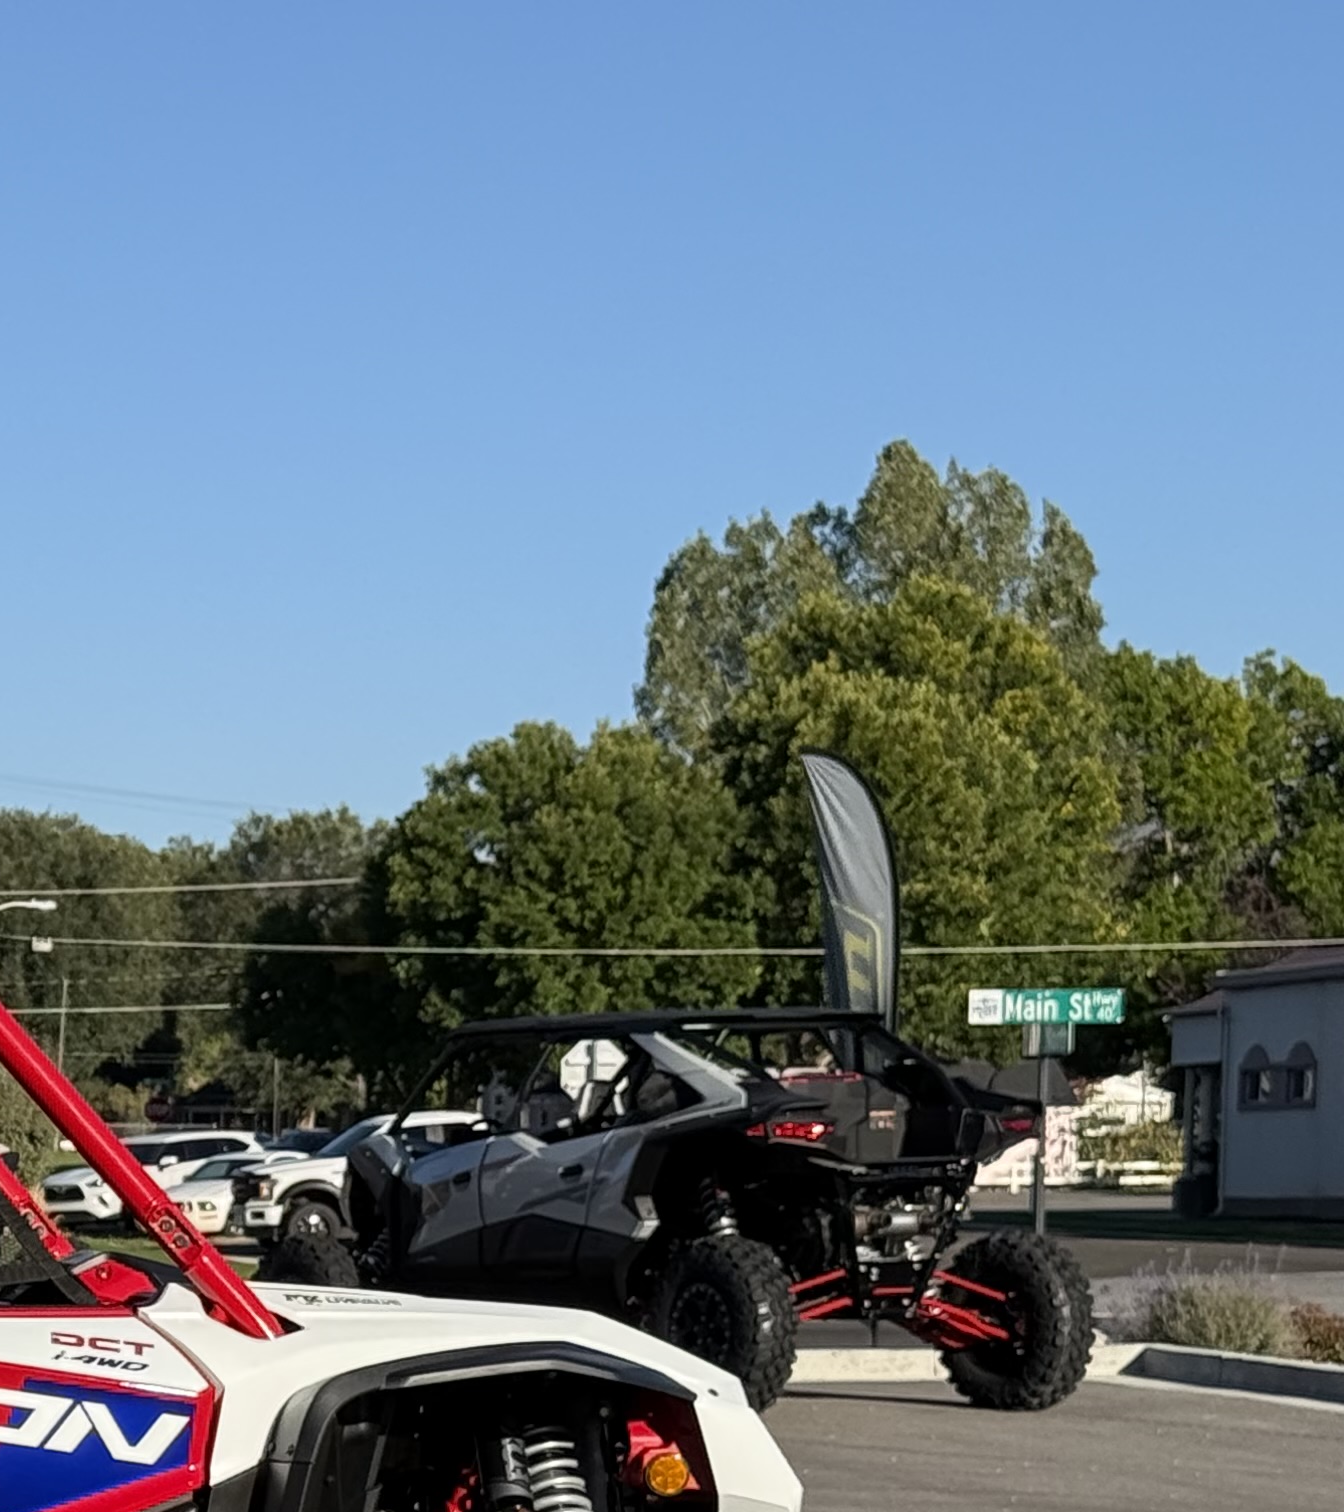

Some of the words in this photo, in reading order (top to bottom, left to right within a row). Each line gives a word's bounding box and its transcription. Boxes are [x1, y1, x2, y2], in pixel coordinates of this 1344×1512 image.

[1004, 991, 1059, 1022] Main
[1068, 991, 1092, 1022] St
[50, 1331, 155, 1356] DCT
